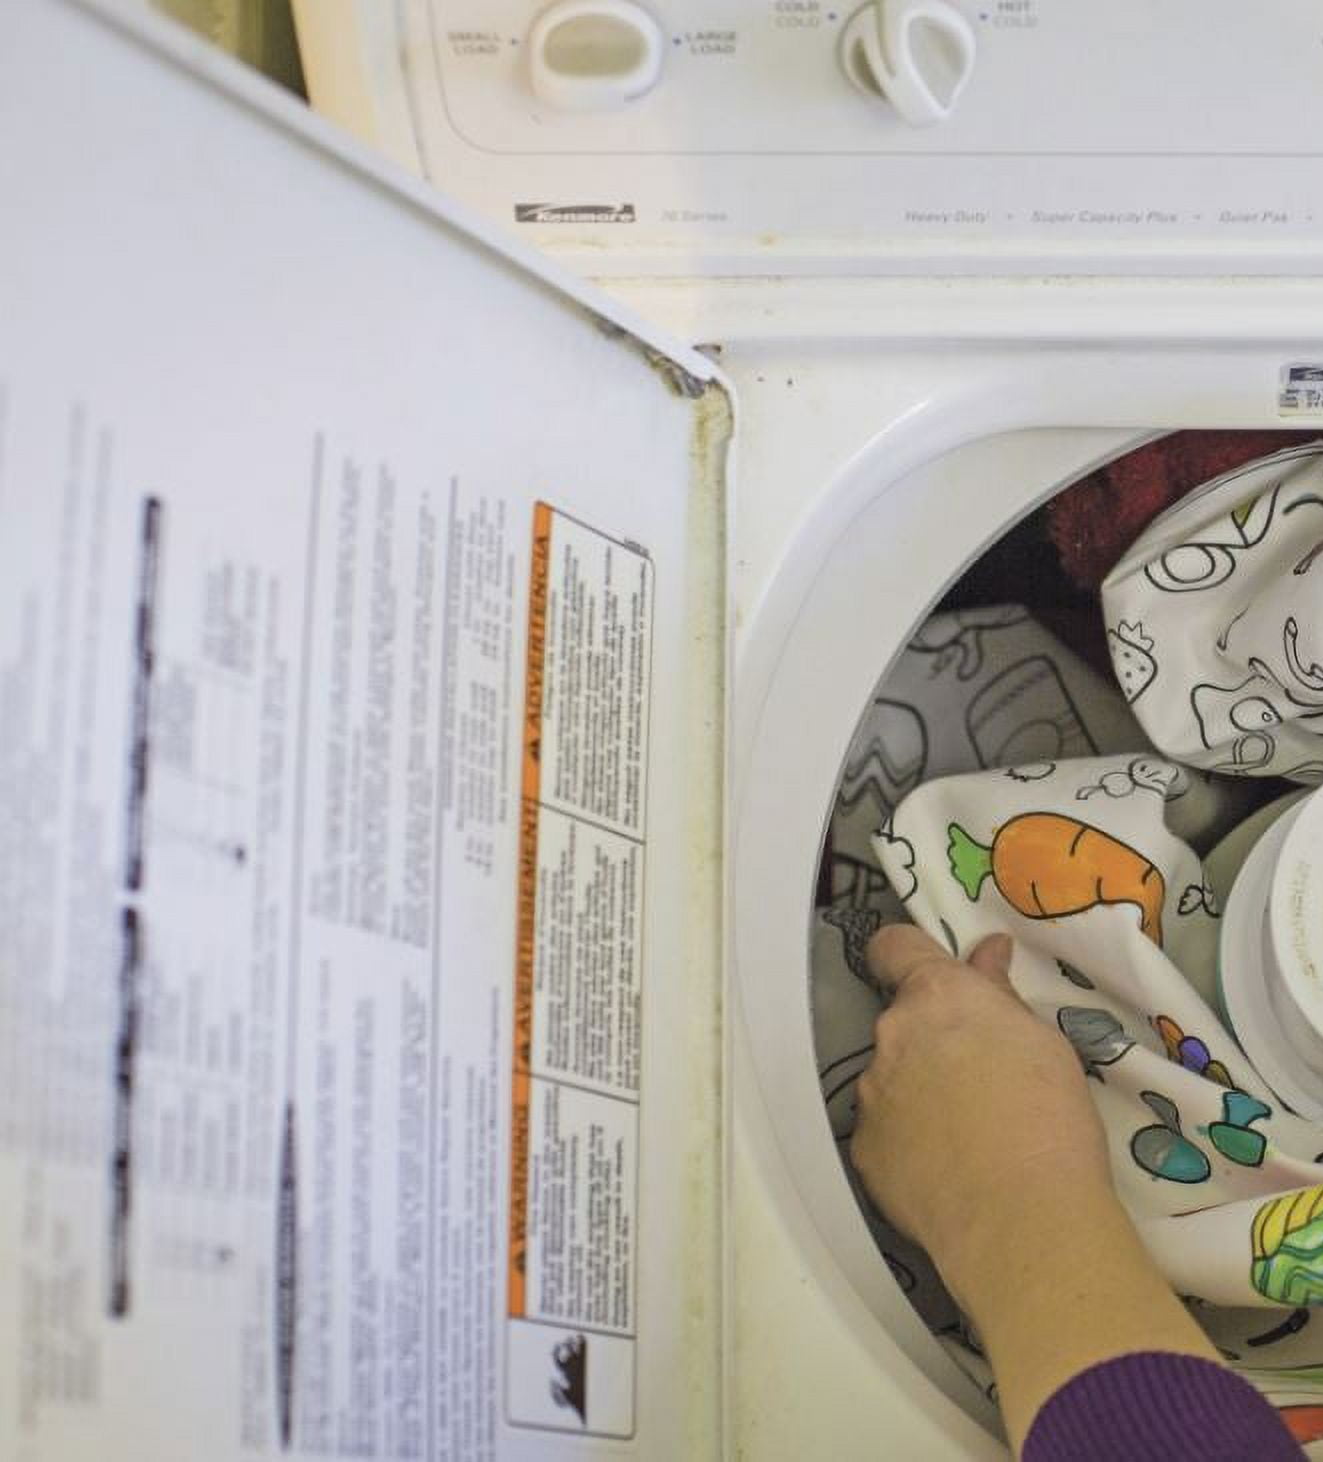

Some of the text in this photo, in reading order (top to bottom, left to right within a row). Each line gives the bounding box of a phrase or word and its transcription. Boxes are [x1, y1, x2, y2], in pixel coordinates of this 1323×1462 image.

[448, 31, 501, 42] SMALL
[684, 31, 736, 42] LARGE
[453, 44, 500, 56] LOAD
[690, 44, 736, 56] LOAD
[905, 210, 990, 225] Heavy Duty
[1030, 210, 1179, 225] Super Capacity Plus
[526, 536, 550, 720] ADVERTENCIA
[510, 1104, 529, 1242] WARNING
